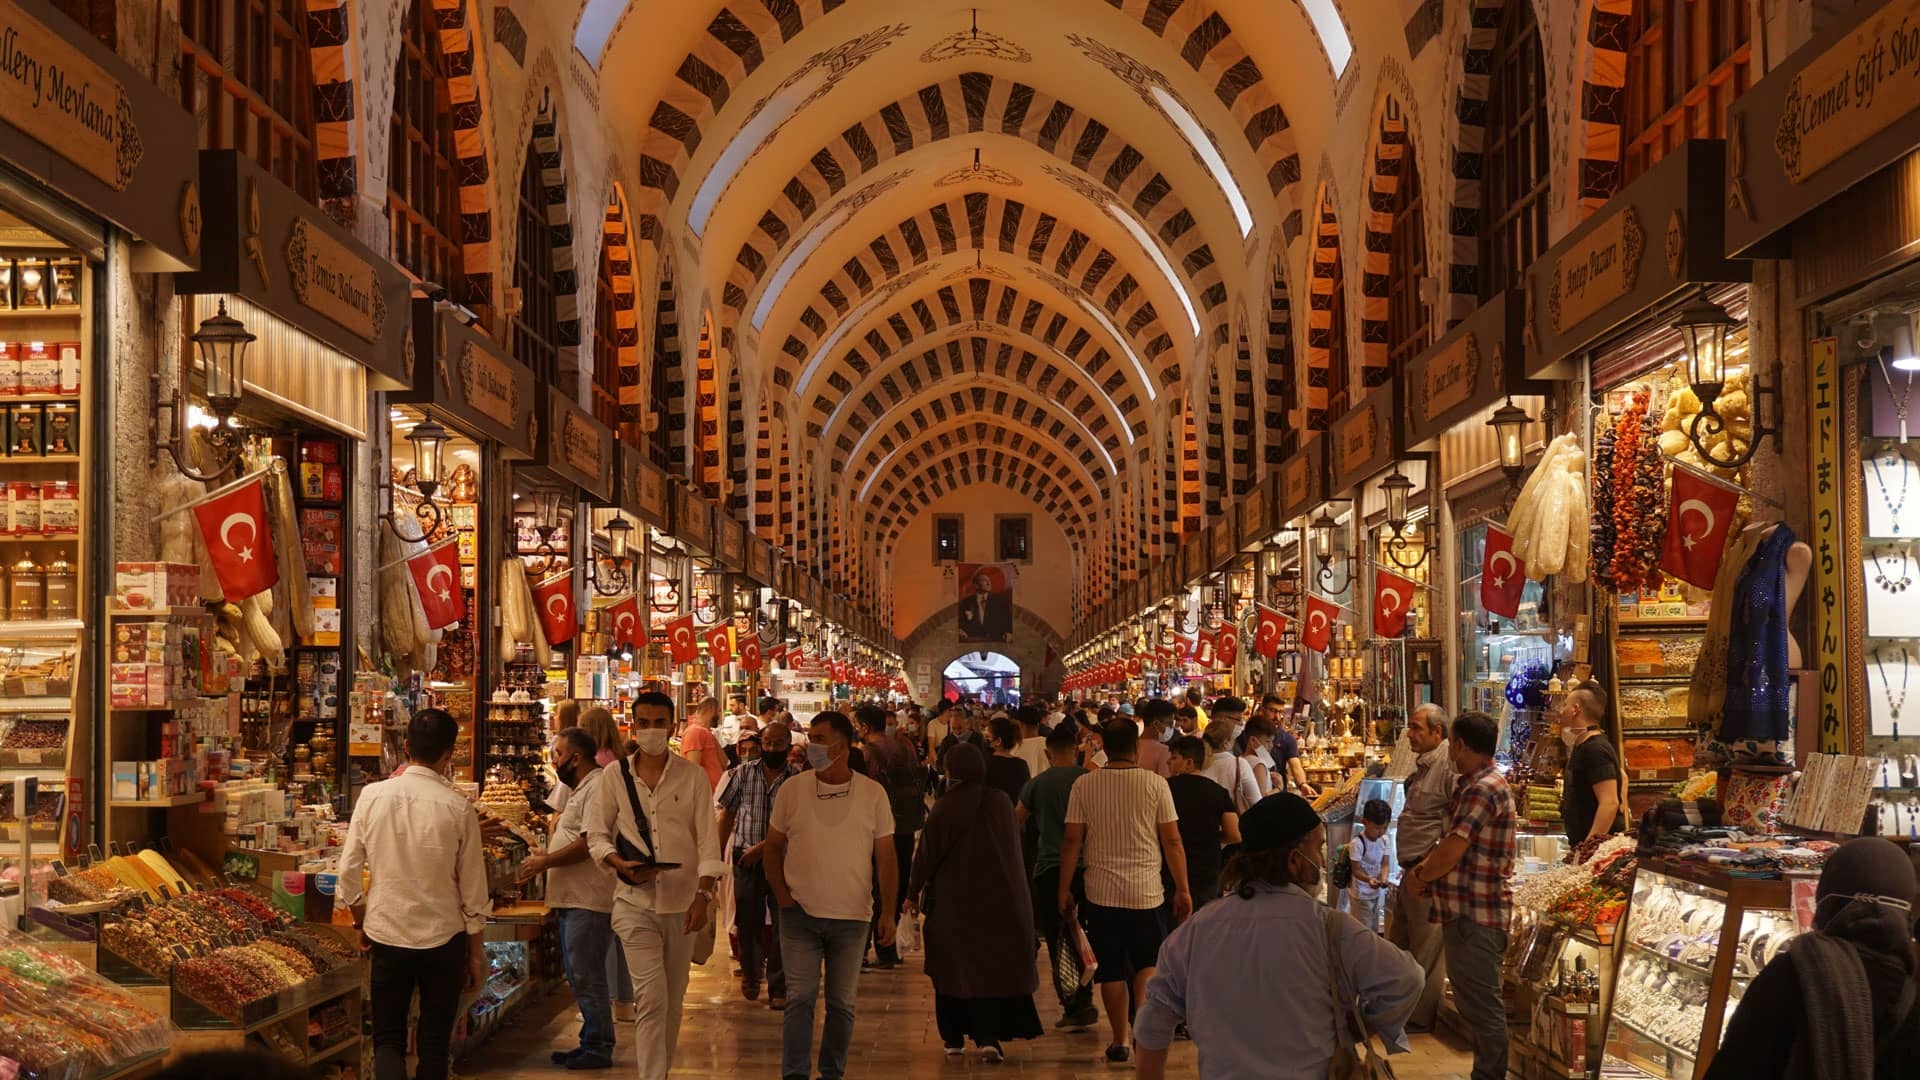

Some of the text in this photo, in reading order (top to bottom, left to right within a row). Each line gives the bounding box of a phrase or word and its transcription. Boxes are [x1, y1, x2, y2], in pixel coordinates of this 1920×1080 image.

[0, 27, 113, 143] llery Mevlana
[1802, 16, 1920, 135] Cennet Gift Sho
[189, 203, 198, 235] 41
